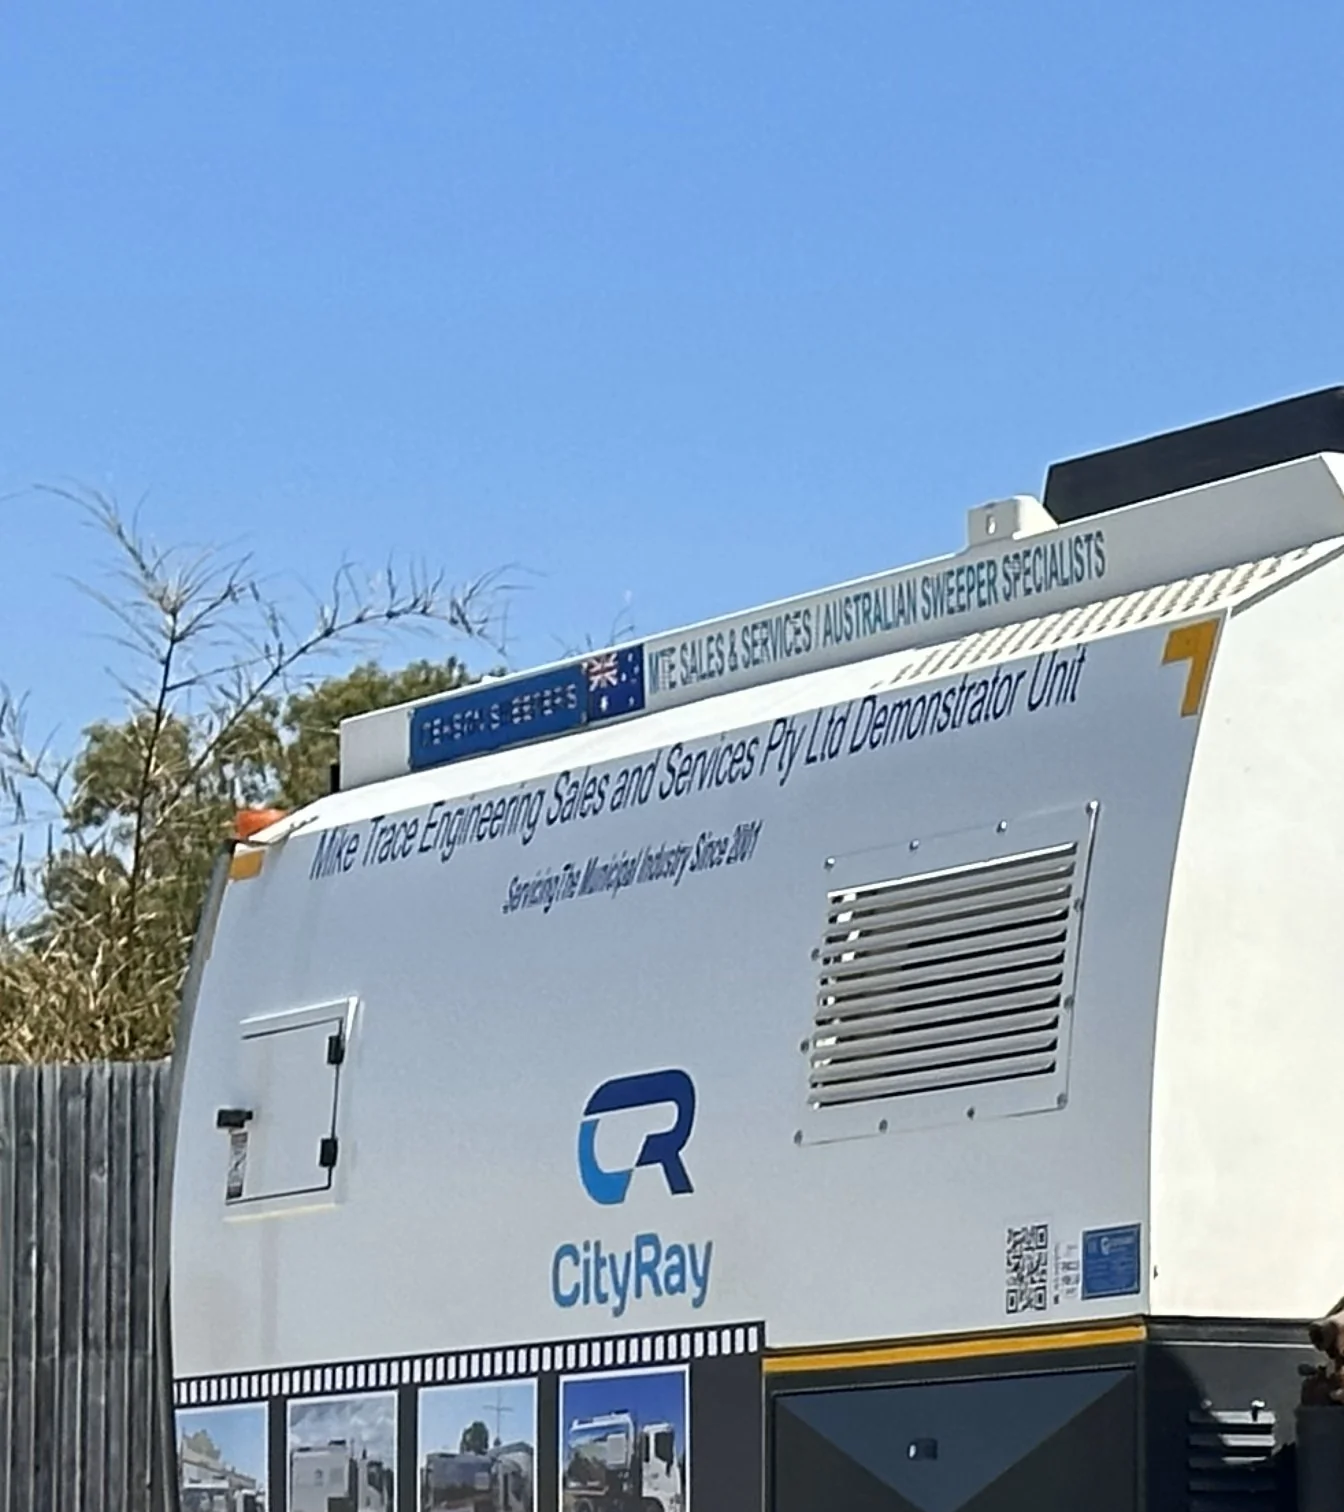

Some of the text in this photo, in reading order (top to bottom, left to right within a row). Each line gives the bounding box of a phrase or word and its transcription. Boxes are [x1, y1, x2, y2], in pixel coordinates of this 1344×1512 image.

[680, 631, 725, 686] SALES
[728, 628, 739, 672] &
[742, 608, 812, 669] SERVICES
[822, 579, 917, 648] AUSTRALIAN
[921, 559, 998, 620] SWEEPER
[1002, 531, 1106, 601] SPECIALISTS
[309, 643, 1088, 880] Mike Trace Engineering Sales and Services Pty Ltd Demonstrator Unit
[552, 1232, 713, 1318] CityRay
